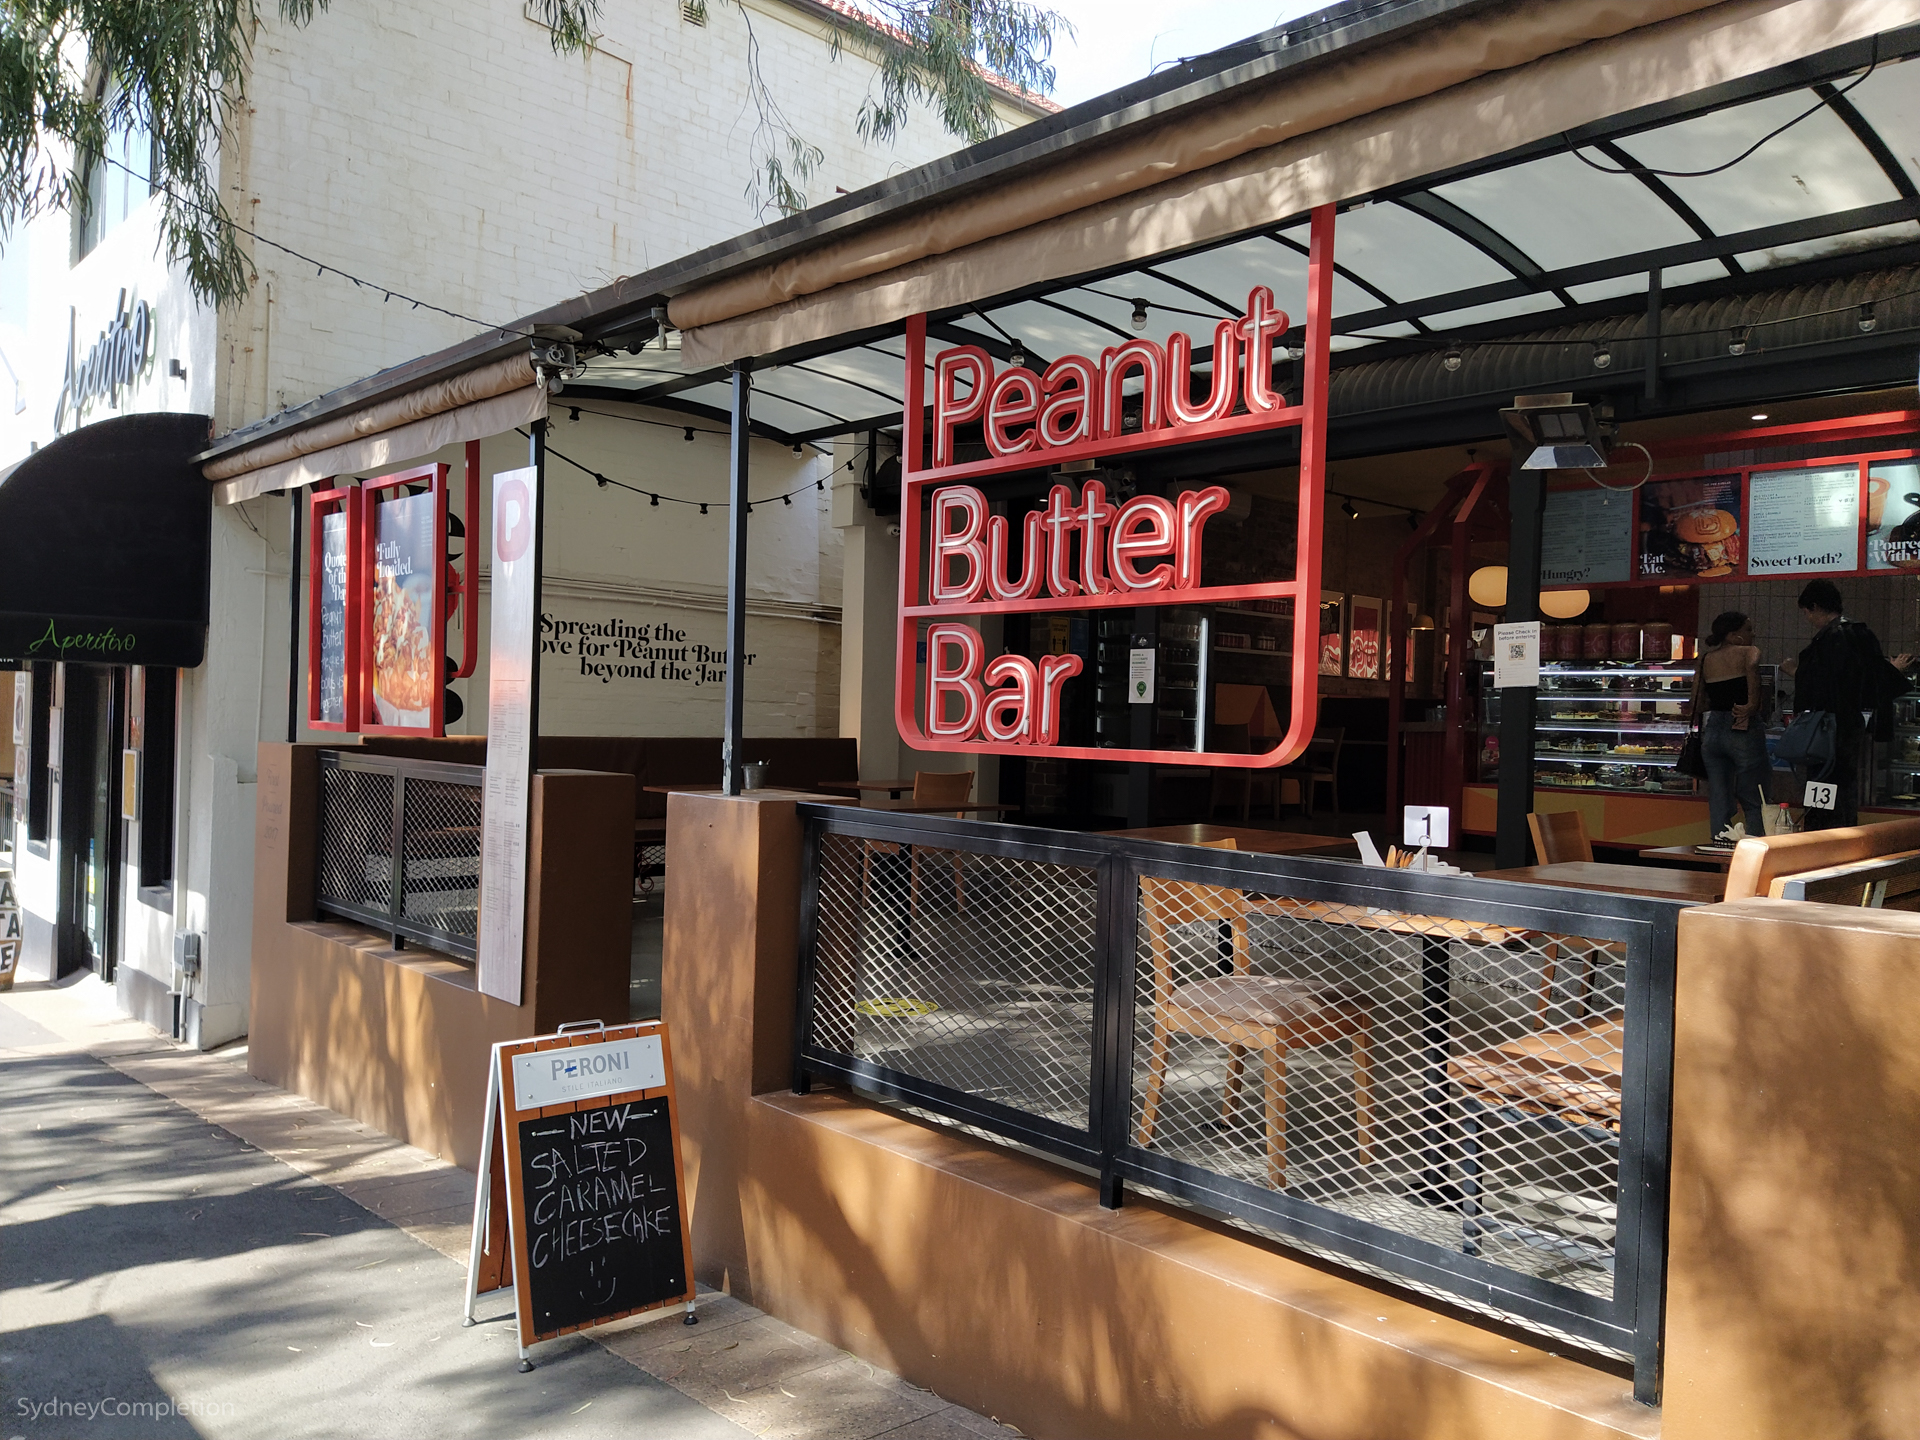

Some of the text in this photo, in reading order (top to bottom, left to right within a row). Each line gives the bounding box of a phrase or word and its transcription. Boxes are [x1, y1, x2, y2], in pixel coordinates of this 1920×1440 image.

[54, 287, 150, 439] Aperitivo
[932, 284, 1290, 470] Peanut
[376, 540, 401, 565] Fully
[928, 479, 1231, 606] Butter
[1869, 550, 1911, 562] With
[324, 552, 347, 573] Quote
[1640, 553, 1665, 564] Eat
[1640, 564, 1666, 574] Me.
[1751, 552, 1842, 568] Sweet Tooth?
[328, 567, 347, 585] of th
[1540, 567, 1591, 582] Hungry?
[24, 617, 136, 659] Aperitivo
[540, 612, 687, 646] Spreading the
[540, 635, 757, 666] ove for Peanut Butr
[580, 656, 727, 687] beyond the Jar
[925, 622, 1083, 747] Bar
[1811, 786, 1832, 805] 13
[1421, 813, 1432, 839] 1
[551, 1051, 630, 1081] PERONI
[562, 1076, 623, 1093] STILE ITALIANO
[570, 1104, 631, 1140] NEW
[530, 1137, 648, 1189] SALTED
[533, 1170, 667, 1225] CARAMEL
[532, 1205, 672, 1268] CHEESECAKE
